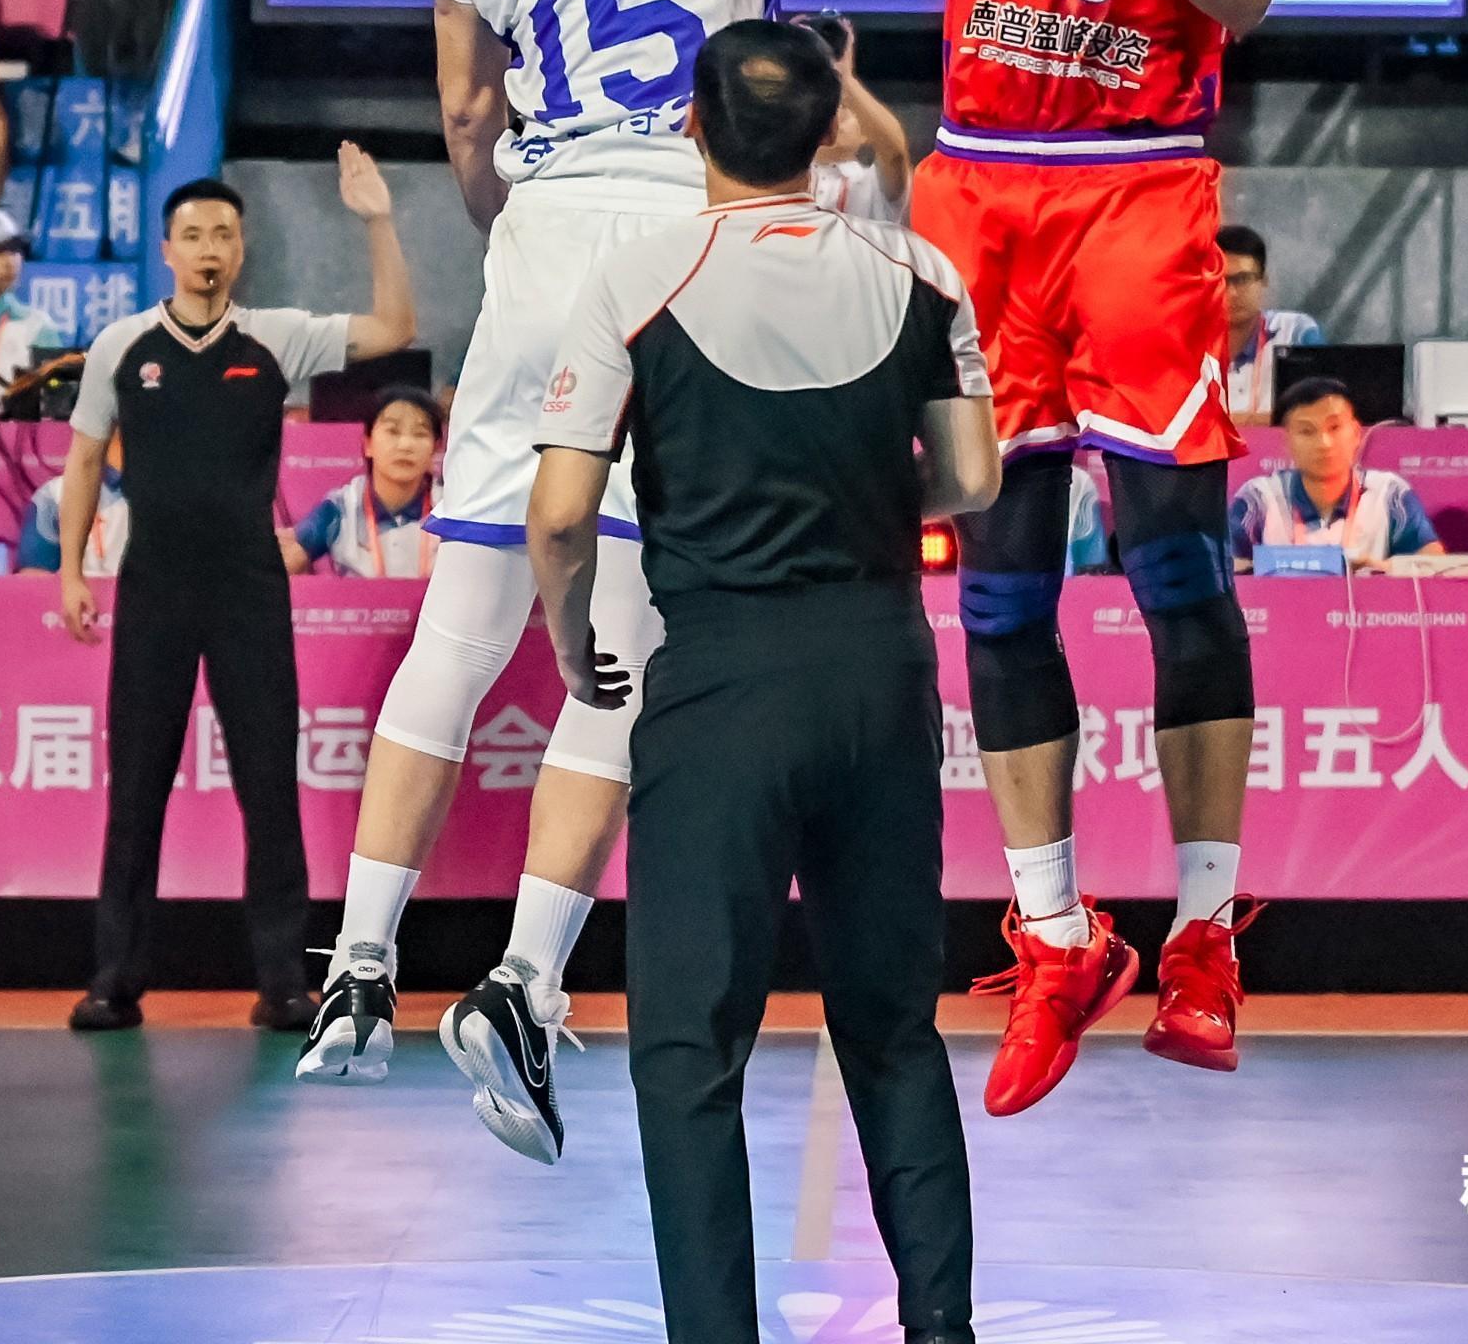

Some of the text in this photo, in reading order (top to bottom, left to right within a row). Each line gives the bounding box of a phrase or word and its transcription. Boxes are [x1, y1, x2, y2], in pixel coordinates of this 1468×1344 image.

[963, 0, 1150, 74] 德普盈峰投资
